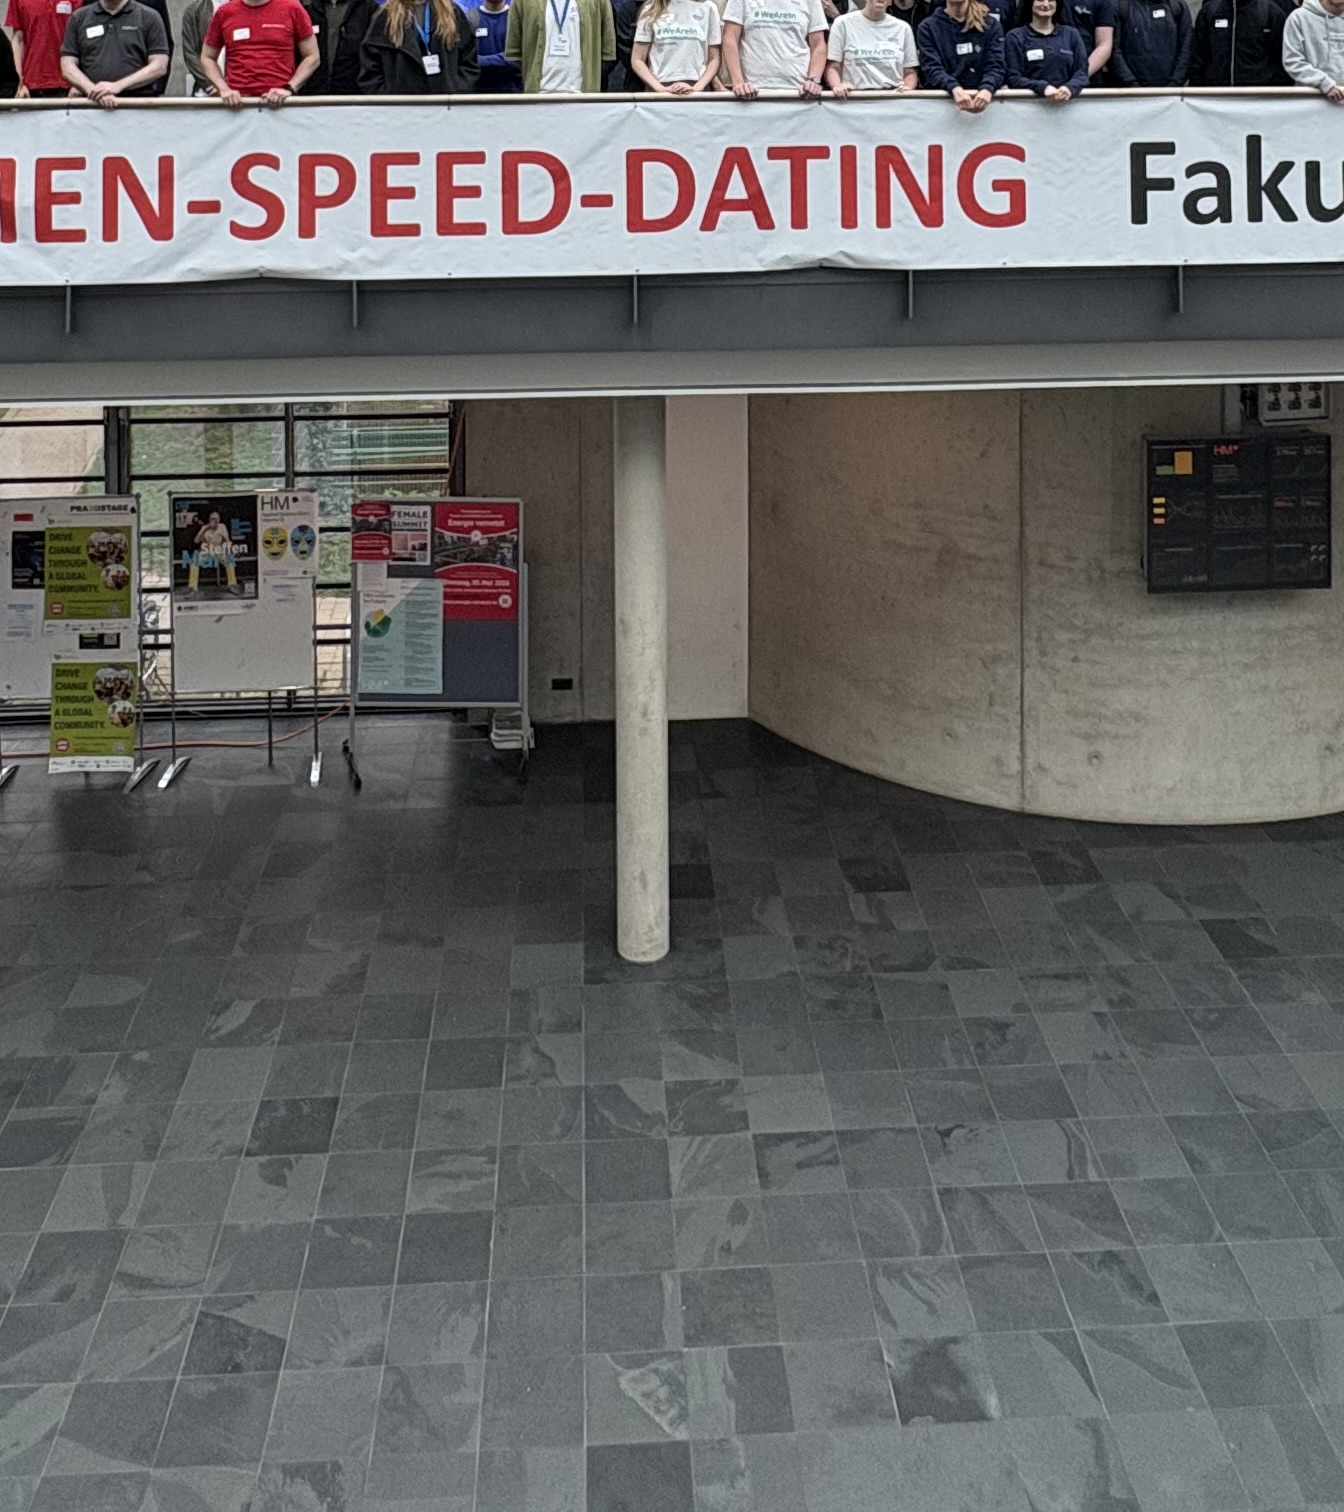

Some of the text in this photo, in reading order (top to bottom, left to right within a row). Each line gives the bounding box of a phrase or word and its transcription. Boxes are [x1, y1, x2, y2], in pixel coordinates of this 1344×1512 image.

[260, 495, 290, 511] HM
[392, 510, 428, 519] FEMALE
[201, 541, 249, 554] Steffen
